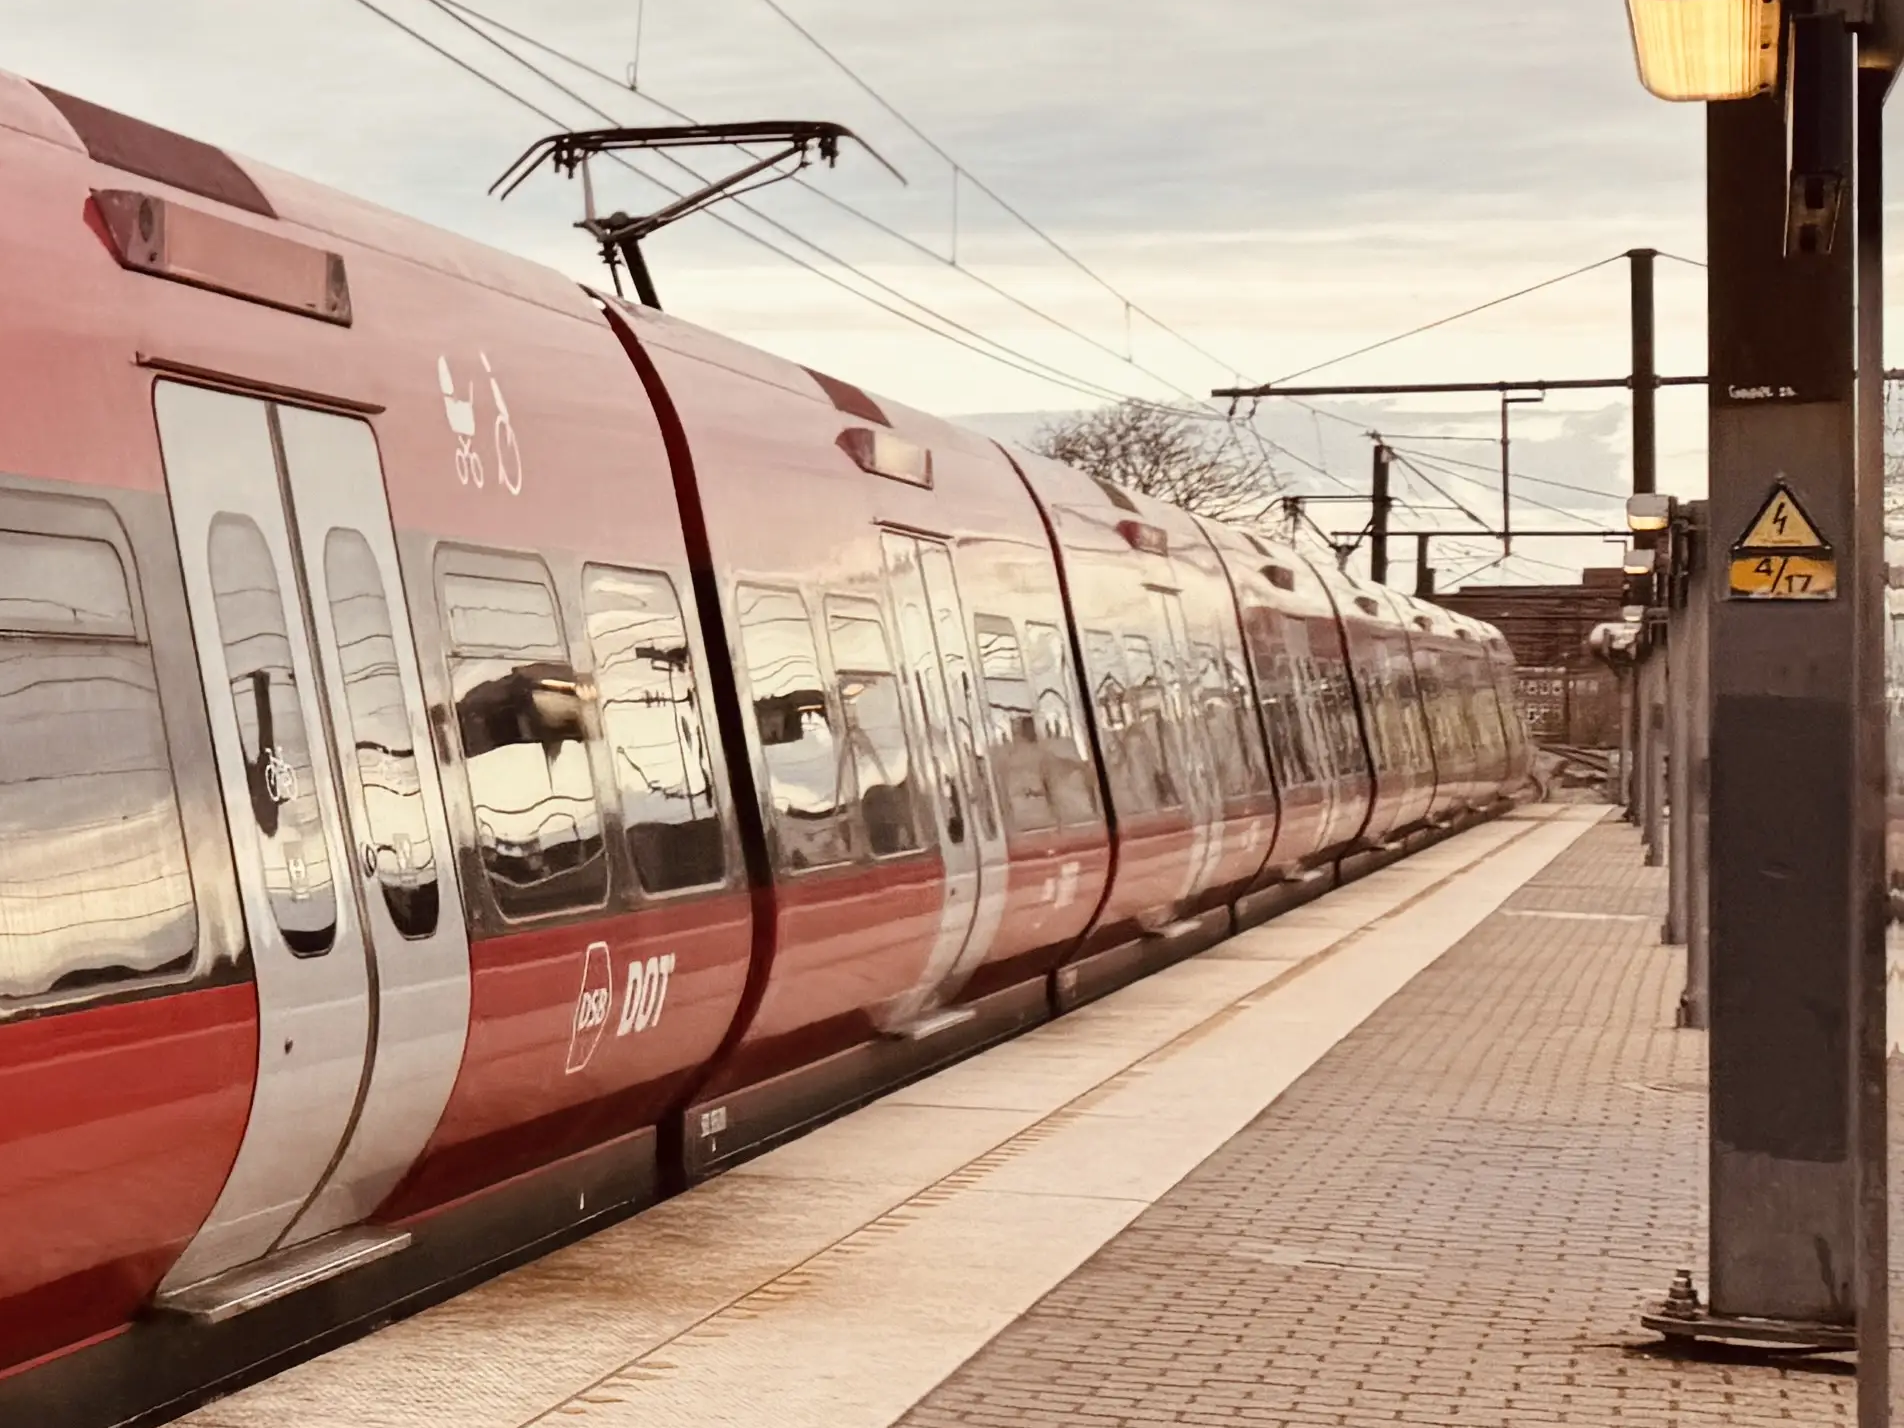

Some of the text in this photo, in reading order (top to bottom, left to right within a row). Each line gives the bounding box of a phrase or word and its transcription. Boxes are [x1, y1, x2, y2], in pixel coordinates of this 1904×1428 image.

[1753, 556, 1814, 594] 4/17
[577, 987, 609, 1032] DSB
[616, 952, 676, 1037] DOT
